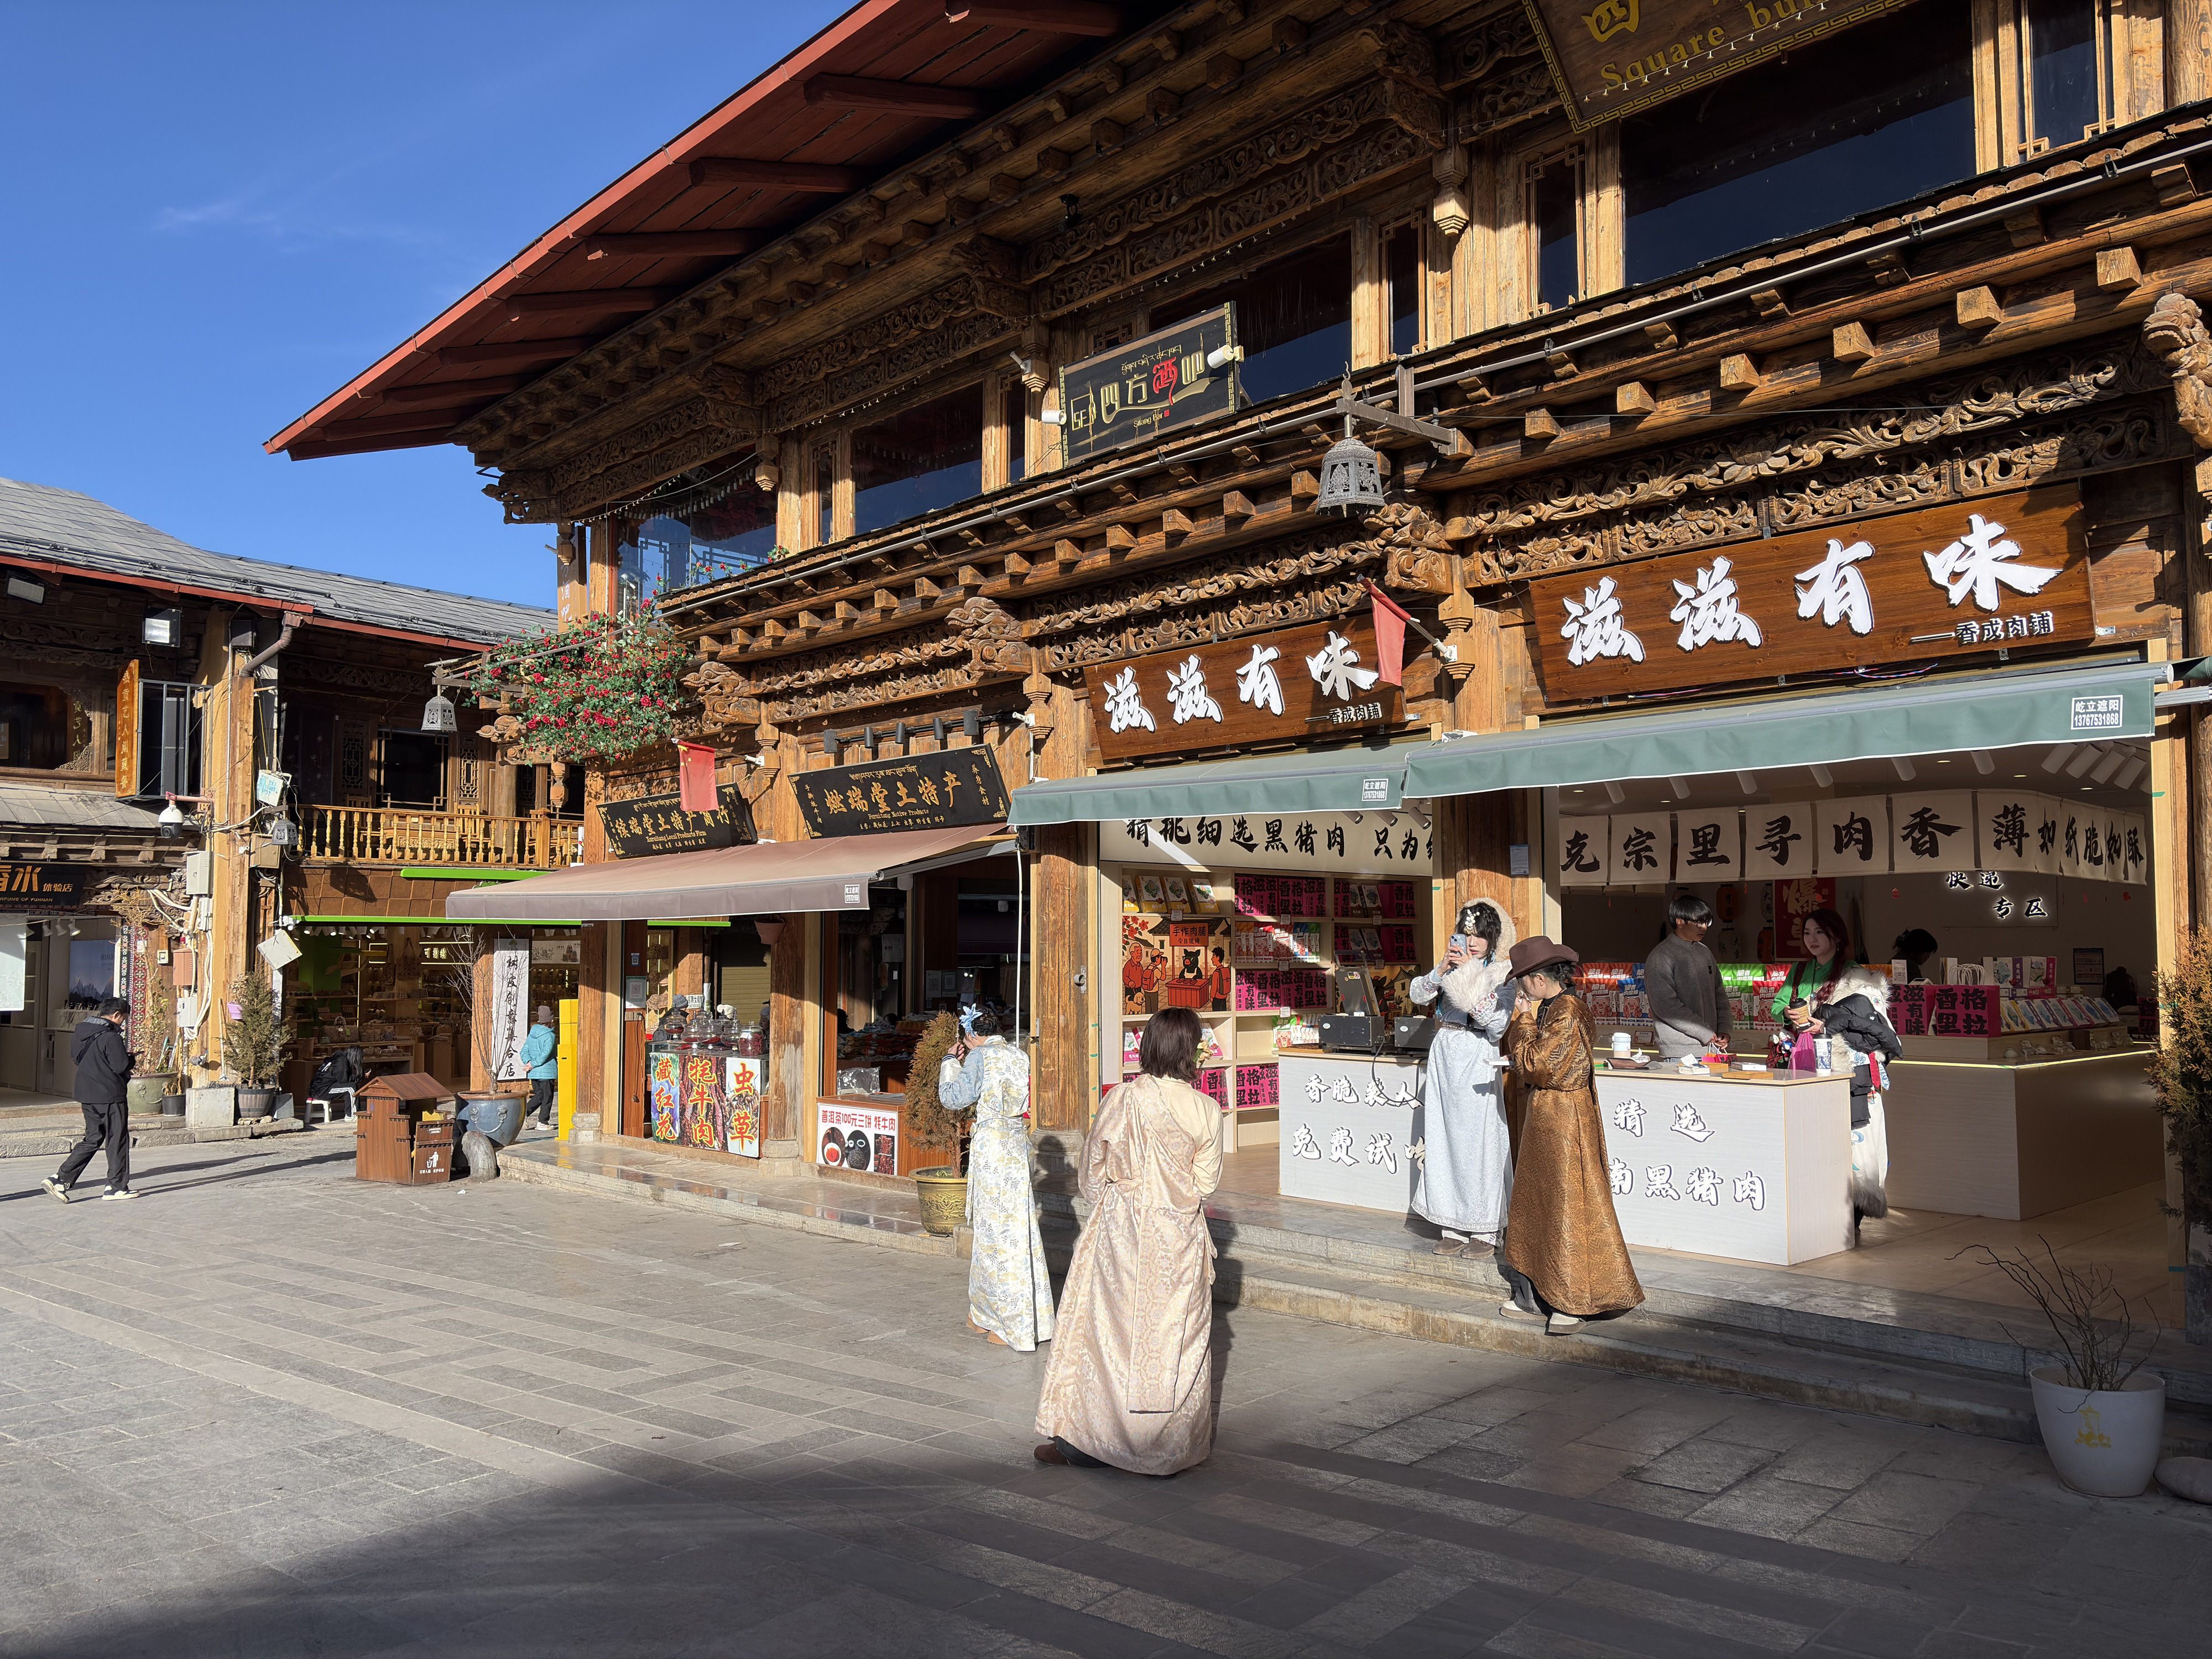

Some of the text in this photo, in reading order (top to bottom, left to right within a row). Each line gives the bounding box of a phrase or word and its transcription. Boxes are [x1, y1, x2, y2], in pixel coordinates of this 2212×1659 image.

[1600, 27, 1726, 88] Square
[1100, 350, 1205, 424] 四方酒吧
[1134, 412, 1164, 427] Sifang Bar
[1561, 514, 2064, 666] 滋滋有味
[1103, 630, 1379, 733] 滋滋有味
[2075, 700, 2119, 713] 屹立遮阳
[2074, 713, 2119, 727] 13767531868
[971, 764, 990, 806] 养身食材
[666, 831, 679, 840] Local
[678, 830, 695, 839] Products
[1126, 815, 1345, 857] 精挑细选黑猪肉
[43, 883, 73, 892] 体验店
[1946, 872, 2005, 890] 快递
[1992, 896, 2048, 920] 专区
[1172, 926, 1206, 937] 手作肉脯
[1733, 937, 1741, 959] 大雪
[1936, 988, 1987, 1011] 香格
[504, 956, 519, 1078] 树皮创意集合店
[1937, 1013, 1989, 1035] 里拉
[655, 1057, 677, 1141] 藏红花
[688, 1057, 717, 1147] 牦牛肉
[730, 1062, 756, 1151] 虫草
[822, 1110, 895, 1131] 普洱茶100元三饼 牦牛肉
[1614, 1098, 1715, 1142] 精选
